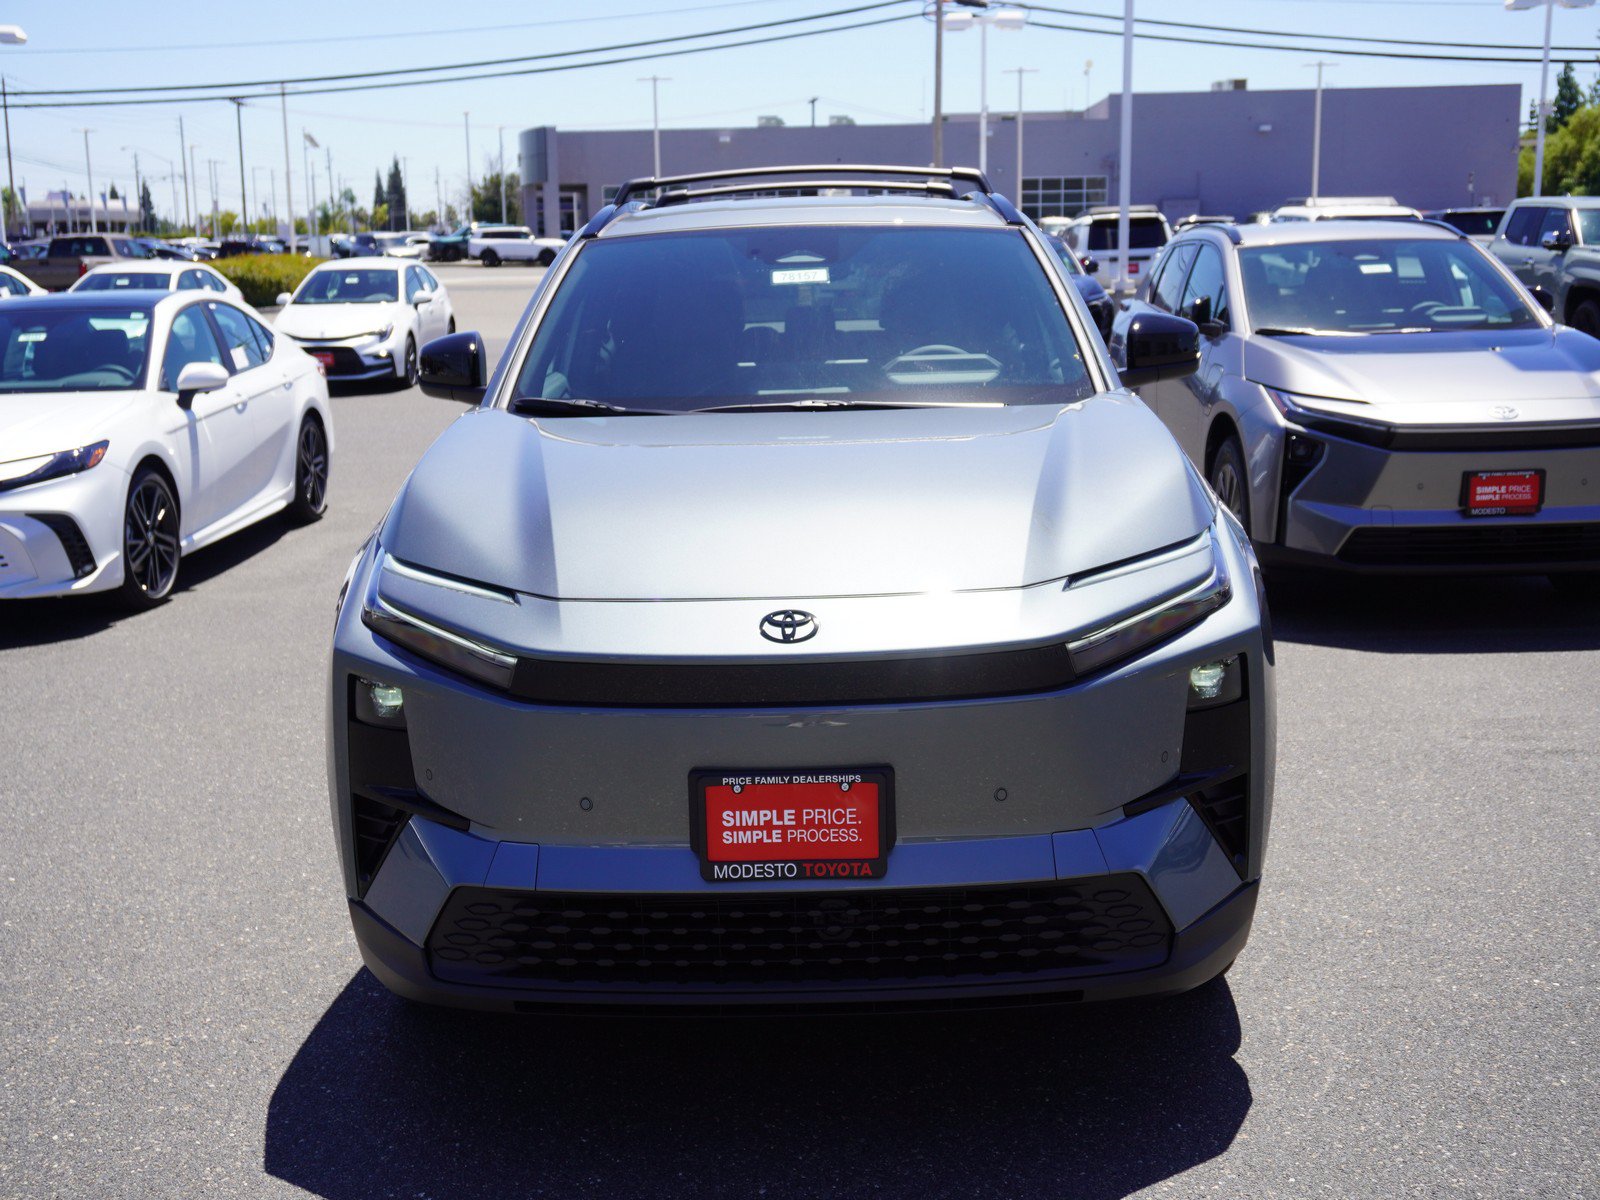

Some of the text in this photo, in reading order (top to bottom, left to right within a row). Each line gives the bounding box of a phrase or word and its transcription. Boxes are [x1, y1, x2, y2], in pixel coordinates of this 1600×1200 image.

[1476, 486, 1507, 494] SIMPLE
[1471, 507, 1506, 515] MODESTO
[722, 774, 862, 786] PRICE FAMILY DEALERSHIPS
[722, 808, 862, 827] SIMPLE PRICE.
[722, 828, 863, 844] SIMPLE PROCESS.
[714, 862, 873, 879] MODESTO TOYOTA
